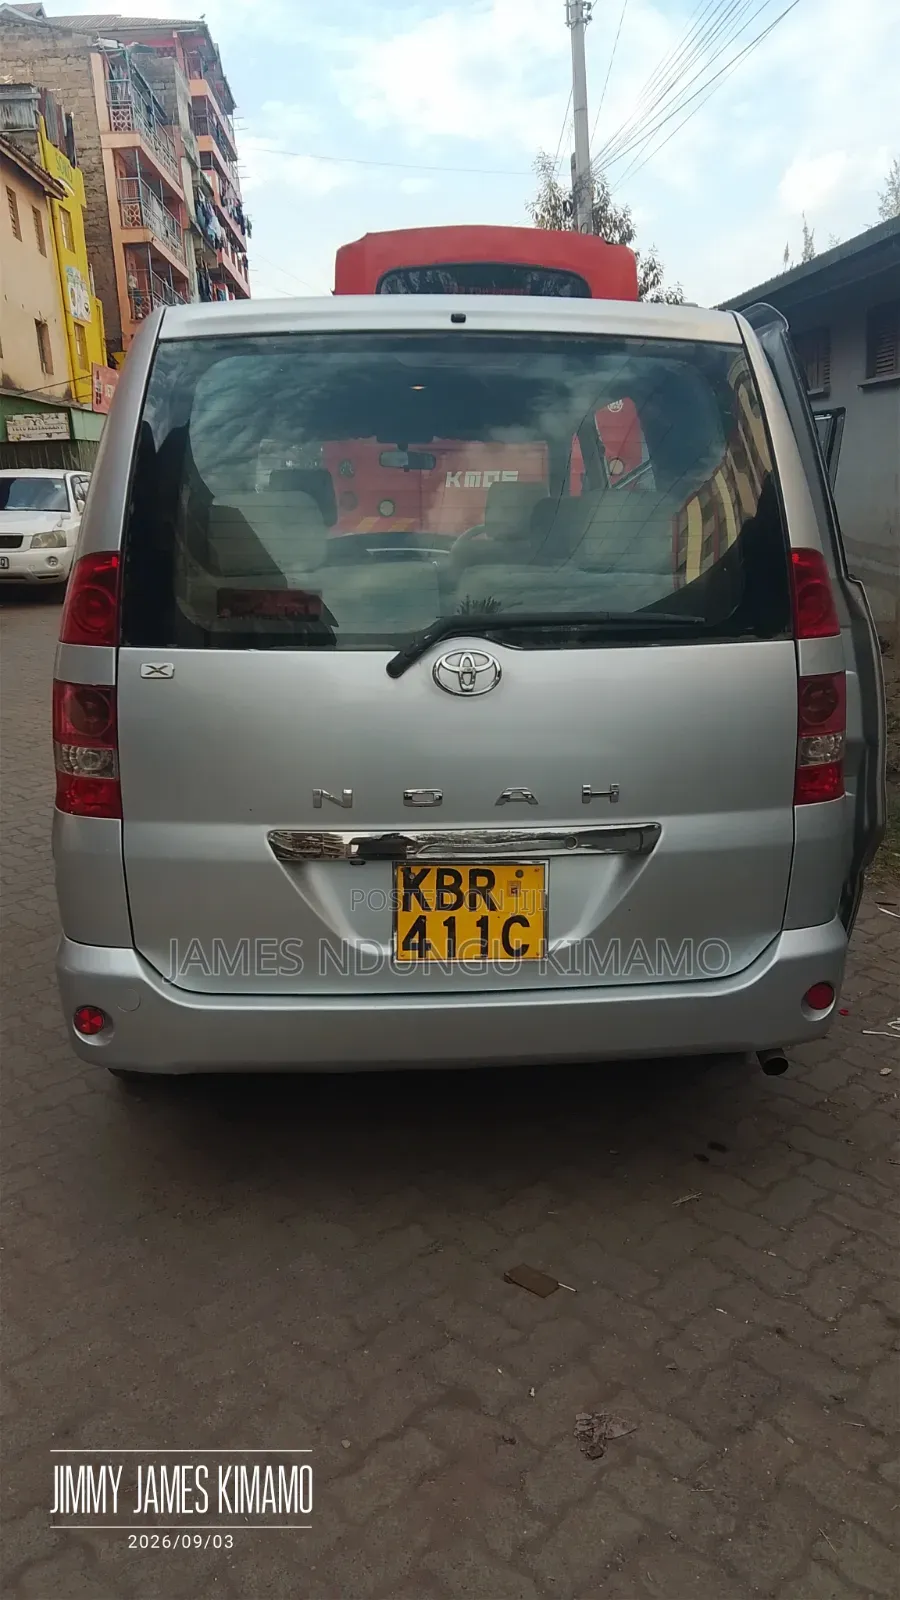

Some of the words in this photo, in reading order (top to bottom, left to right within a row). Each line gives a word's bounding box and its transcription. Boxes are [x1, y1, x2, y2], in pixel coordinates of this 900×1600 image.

[143, 664, 170, 677] X
[312, 783, 620, 809] NOAH
[401, 866, 497, 912] KBR
[401, 915, 531, 958] 411C
